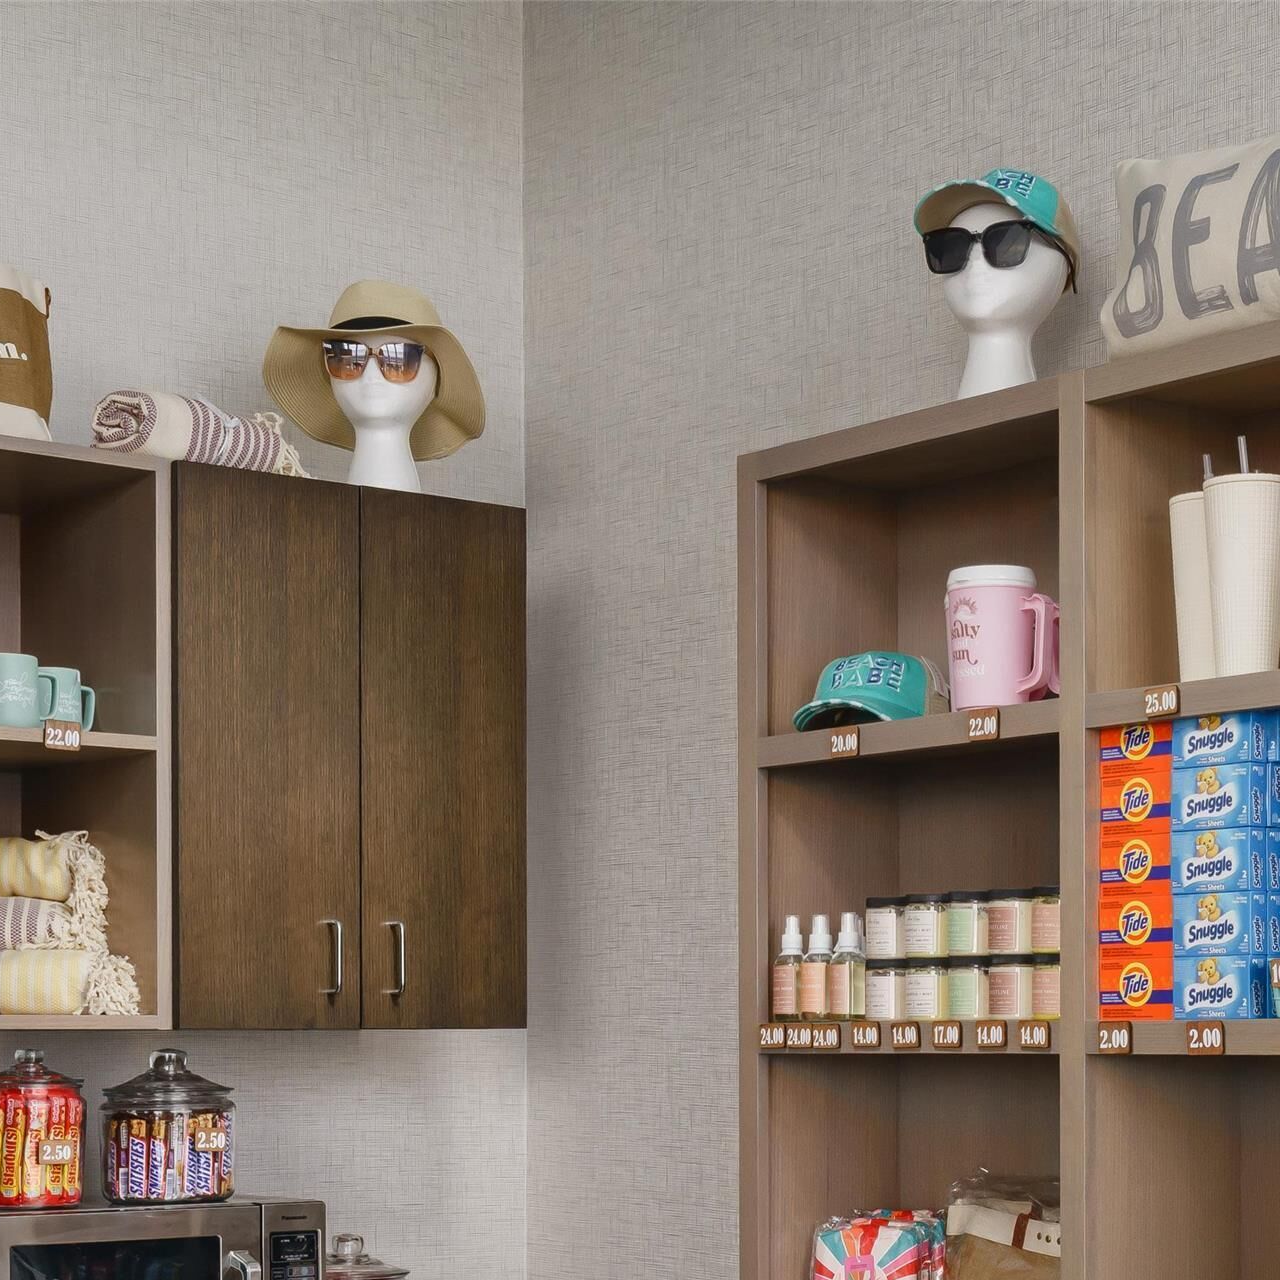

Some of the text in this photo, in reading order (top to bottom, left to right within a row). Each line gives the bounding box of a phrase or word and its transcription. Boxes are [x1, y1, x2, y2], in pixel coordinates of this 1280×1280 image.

[1145, 690, 1176, 714] 25.00
[969, 715, 997, 737] 22.00
[46, 727, 81, 748] 22.00
[831, 733, 857, 753] 20.00
[1124, 728, 1150, 753] Tide
[1187, 727, 1234, 754] Snuggle
[1123, 851, 1149, 876] Tide
[1185, 855, 1233, 881] Snuggle
[1123, 974, 1149, 999] Tide
[1188, 985, 1233, 1007] Snuggle
[760, 1027, 784, 1046] 24.00
[787, 1027, 811, 1046] 24.00
[813, 1027, 837, 1047] 24.00
[853, 1025, 878, 1045] 14.00
[892, 1025, 916, 1045] 14.00
[934, 1025, 959, 1045] 17.00
[976, 1025, 1003, 1045] 14.00
[1020, 1025, 1046, 1046] 14.00
[1099, 1028, 1128, 1049] 2.00
[1189, 1028, 1221, 1049] 2.00
[197, 1131, 226, 1149] 2.50
[43, 1144, 71, 1161] 2.50
